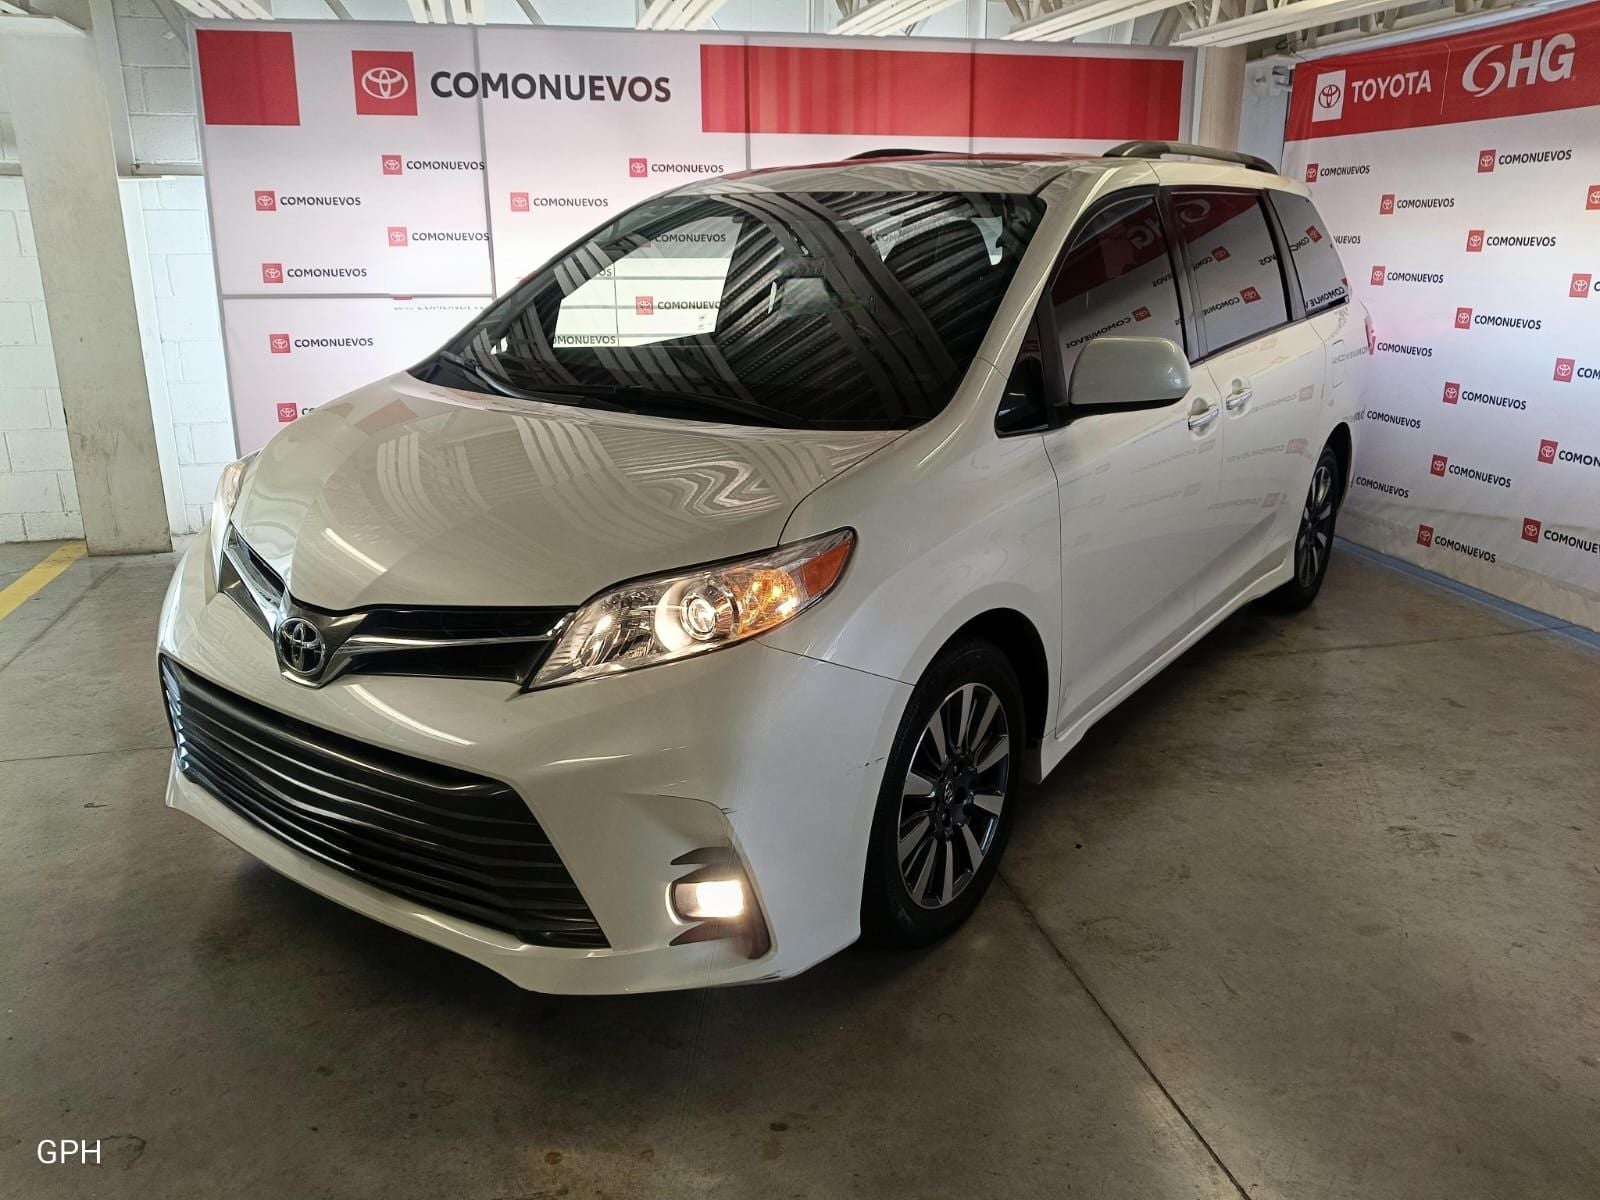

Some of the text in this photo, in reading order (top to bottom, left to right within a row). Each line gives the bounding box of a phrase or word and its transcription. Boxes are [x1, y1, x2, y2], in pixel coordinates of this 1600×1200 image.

[429, 70, 672, 103] COMONUEVOS
[1351, 70, 1432, 103] TOYOTA
[1498, 149, 1573, 166] COMONUEVOS
[406, 160, 486, 171] COMONUEVOS
[651, 163, 725, 173] COMONUEVOS
[1319, 164, 1371, 177] COMONUEVOS
[279, 196, 361, 206] COMONUEVOS
[533, 197, 609, 208] COMONUEVOS
[1396, 197, 1455, 209] COMONUEVOS
[411, 232, 490, 241] COMONUEVOS
[654, 233, 727, 243] COMONUEVOS
[1486, 236, 1557, 247] COMONUEVOS
[286, 268, 368, 278] COMONUEVOS
[1386, 271, 1444, 284] COMONUEVOS
[1474, 314, 1542, 330] COMONUEVOS
[294, 337, 374, 348] COMONUEVOS
[1376, 341, 1433, 358] COMONUEVOS
[1461, 390, 1527, 411] COMONUEVOS
[1366, 410, 1422, 430] COMONUEVOS
[1448, 464, 1512, 489] COMONUEVOS
[1355, 476, 1410, 499] COMONUEVOS
[1434, 535, 1497, 564] COMONUEVOS
